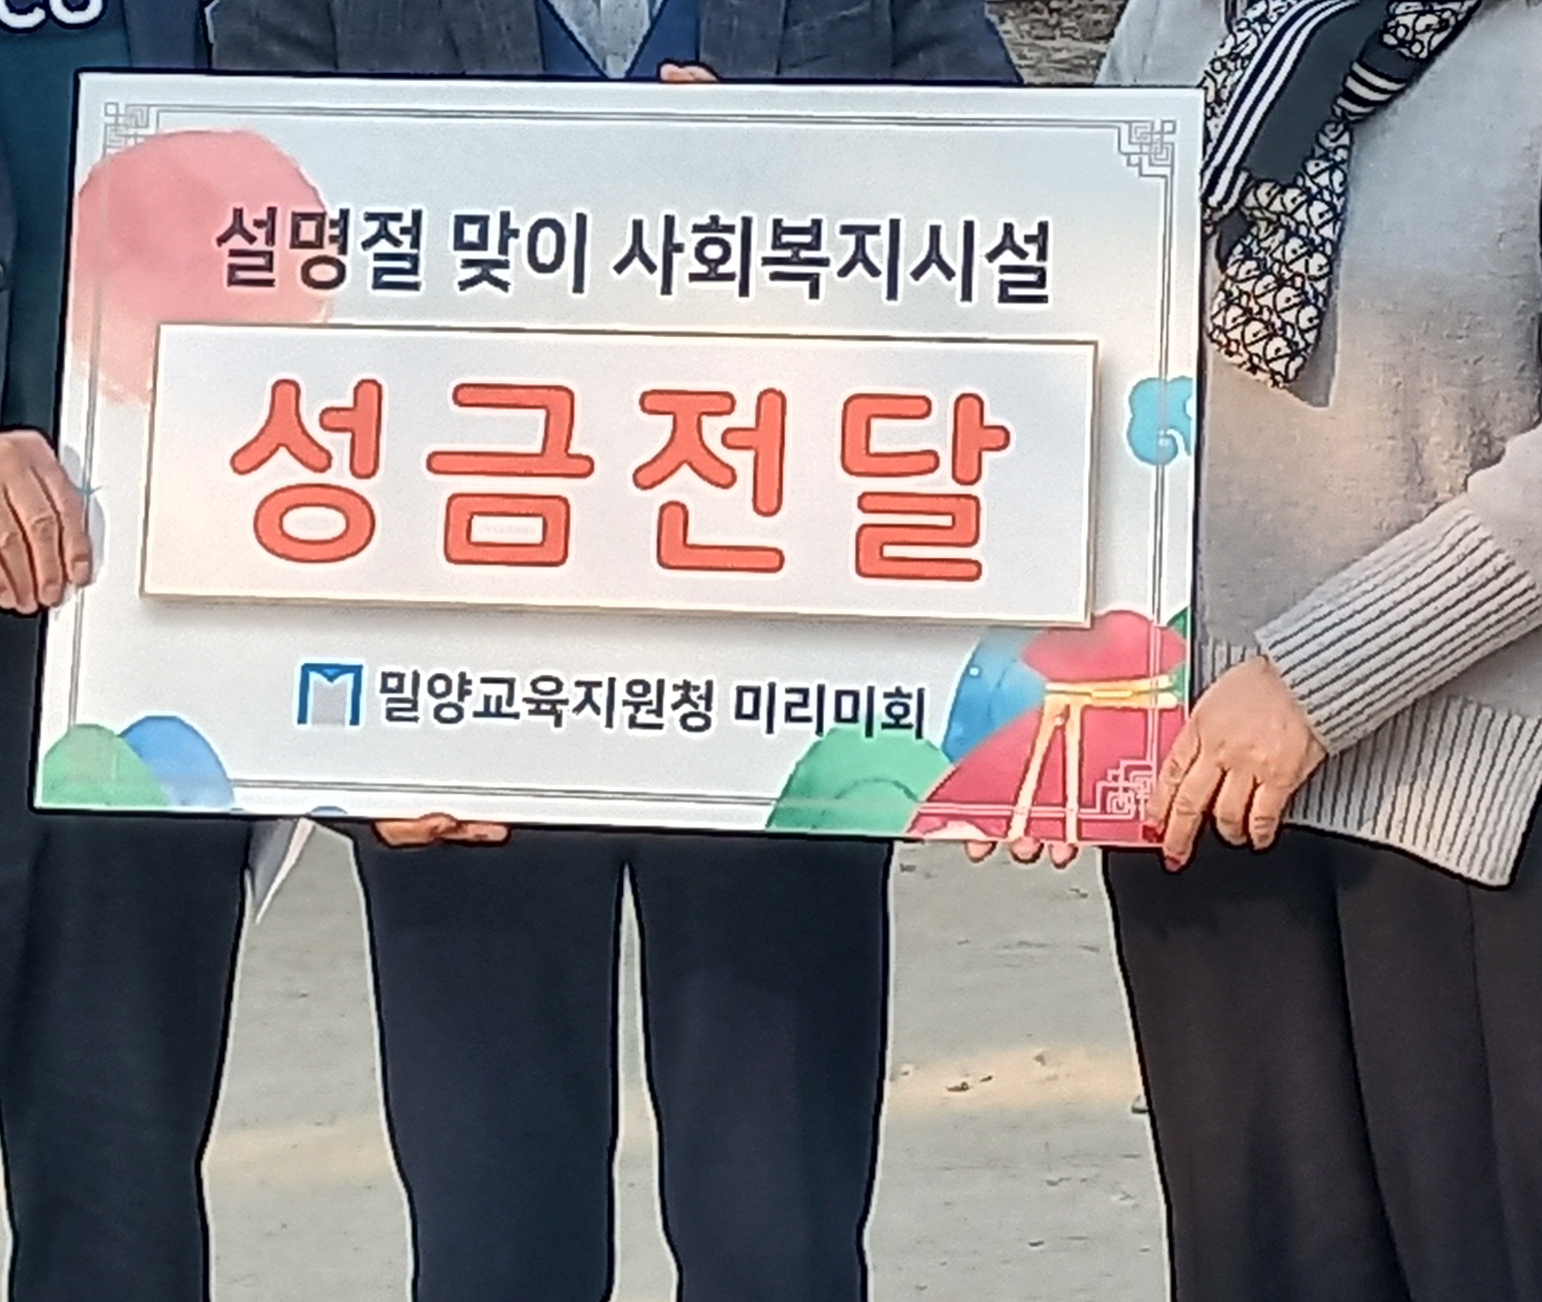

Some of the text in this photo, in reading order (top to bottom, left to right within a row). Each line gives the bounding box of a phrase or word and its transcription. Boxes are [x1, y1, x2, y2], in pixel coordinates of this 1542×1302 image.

[215, 206, 1050, 305] 설명절 맞이 사회복지시설
[229, 378, 1012, 584] 성금전달
[378, 669, 715, 733] 밀양교육지원청
[733, 681, 926, 740] 미리미회
